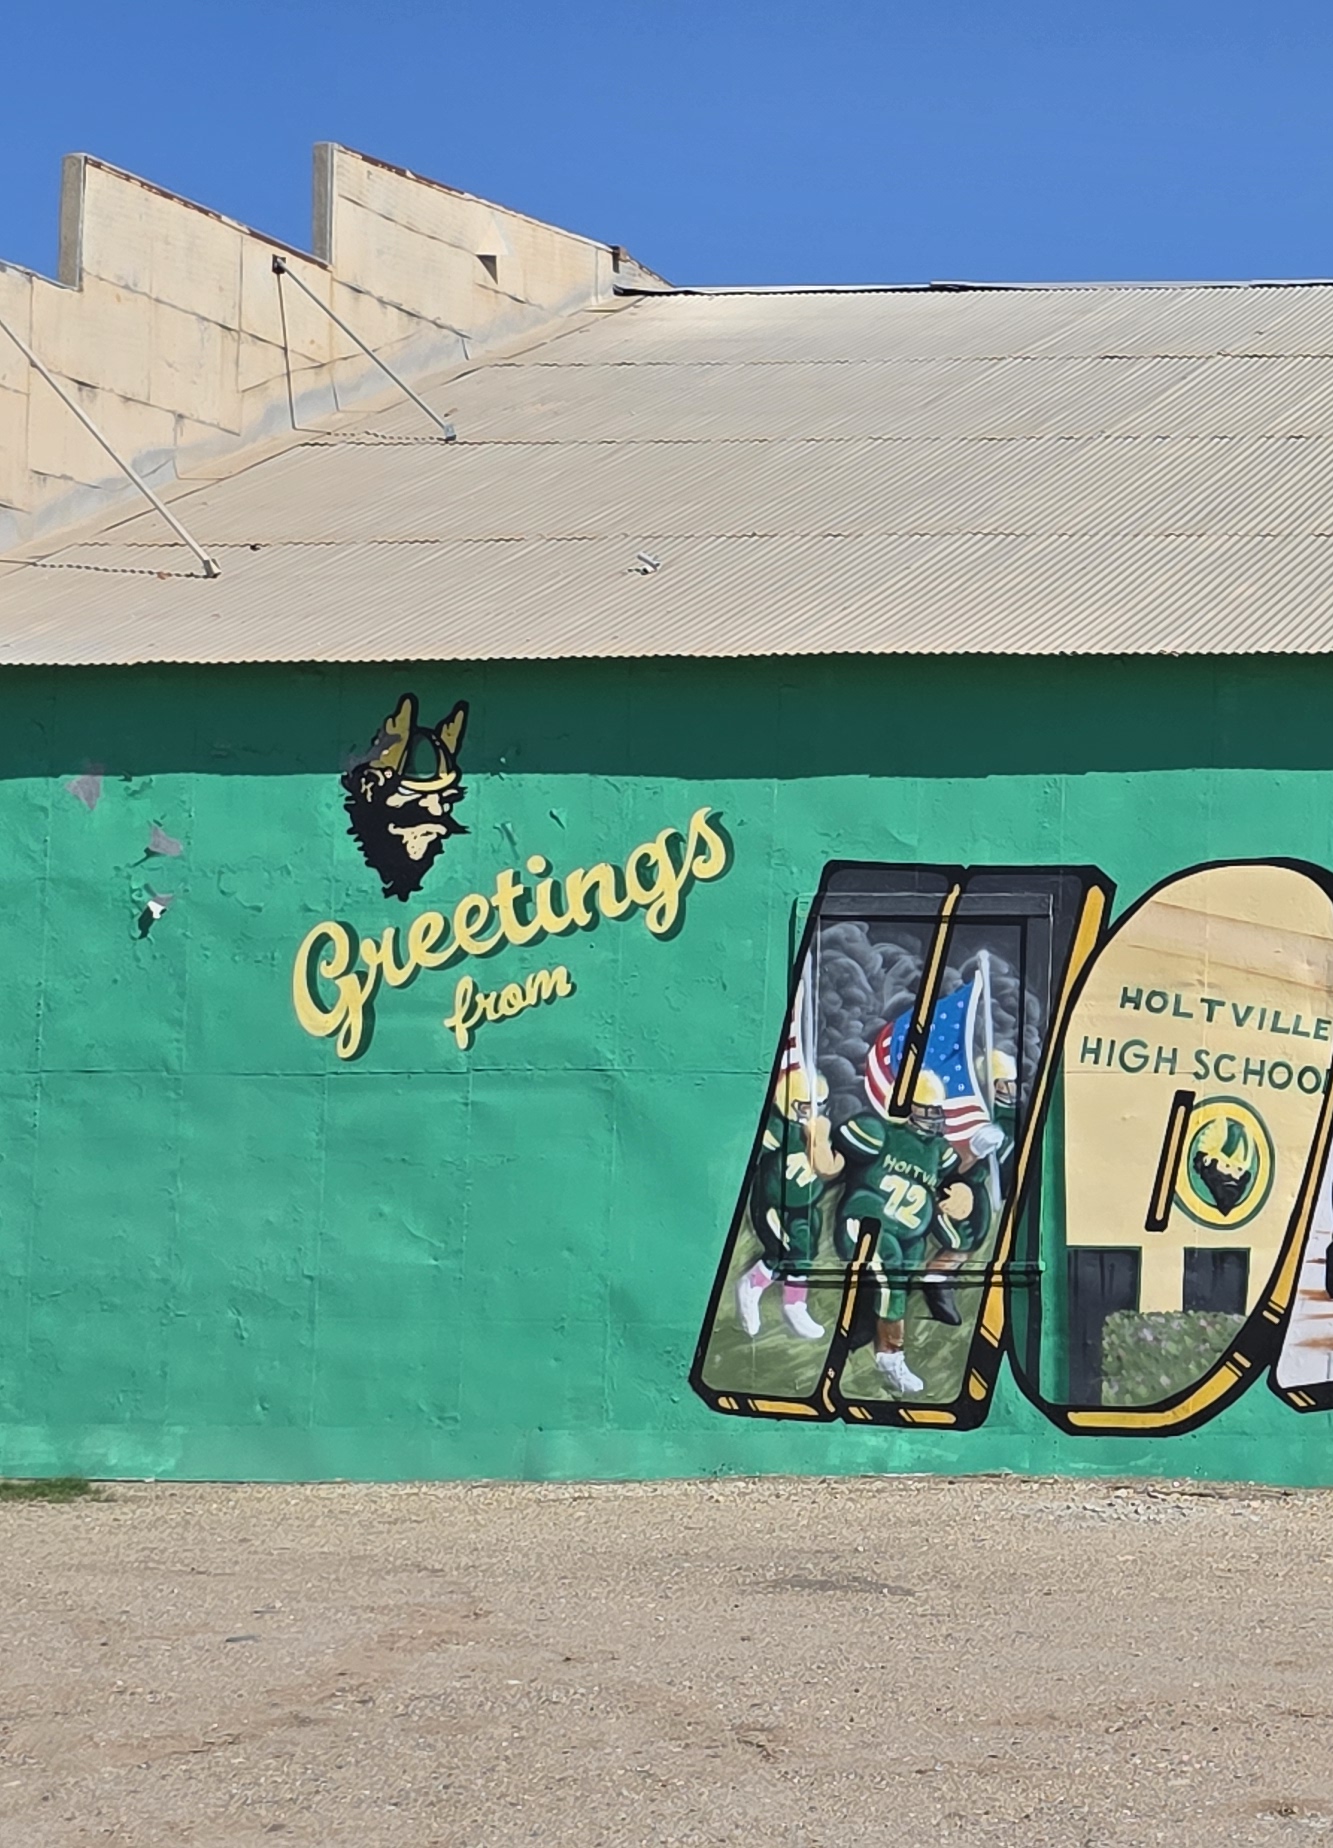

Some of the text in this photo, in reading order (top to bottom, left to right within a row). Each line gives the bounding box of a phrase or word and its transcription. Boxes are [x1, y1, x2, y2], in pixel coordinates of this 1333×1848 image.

[292, 806, 732, 1061] Greetings
[444, 964, 573, 1051] from
[1119, 985, 1332, 1042] HOLTVILLE
[1079, 1035, 1178, 1076] HIGH
[879, 1174, 928, 1230] 72
